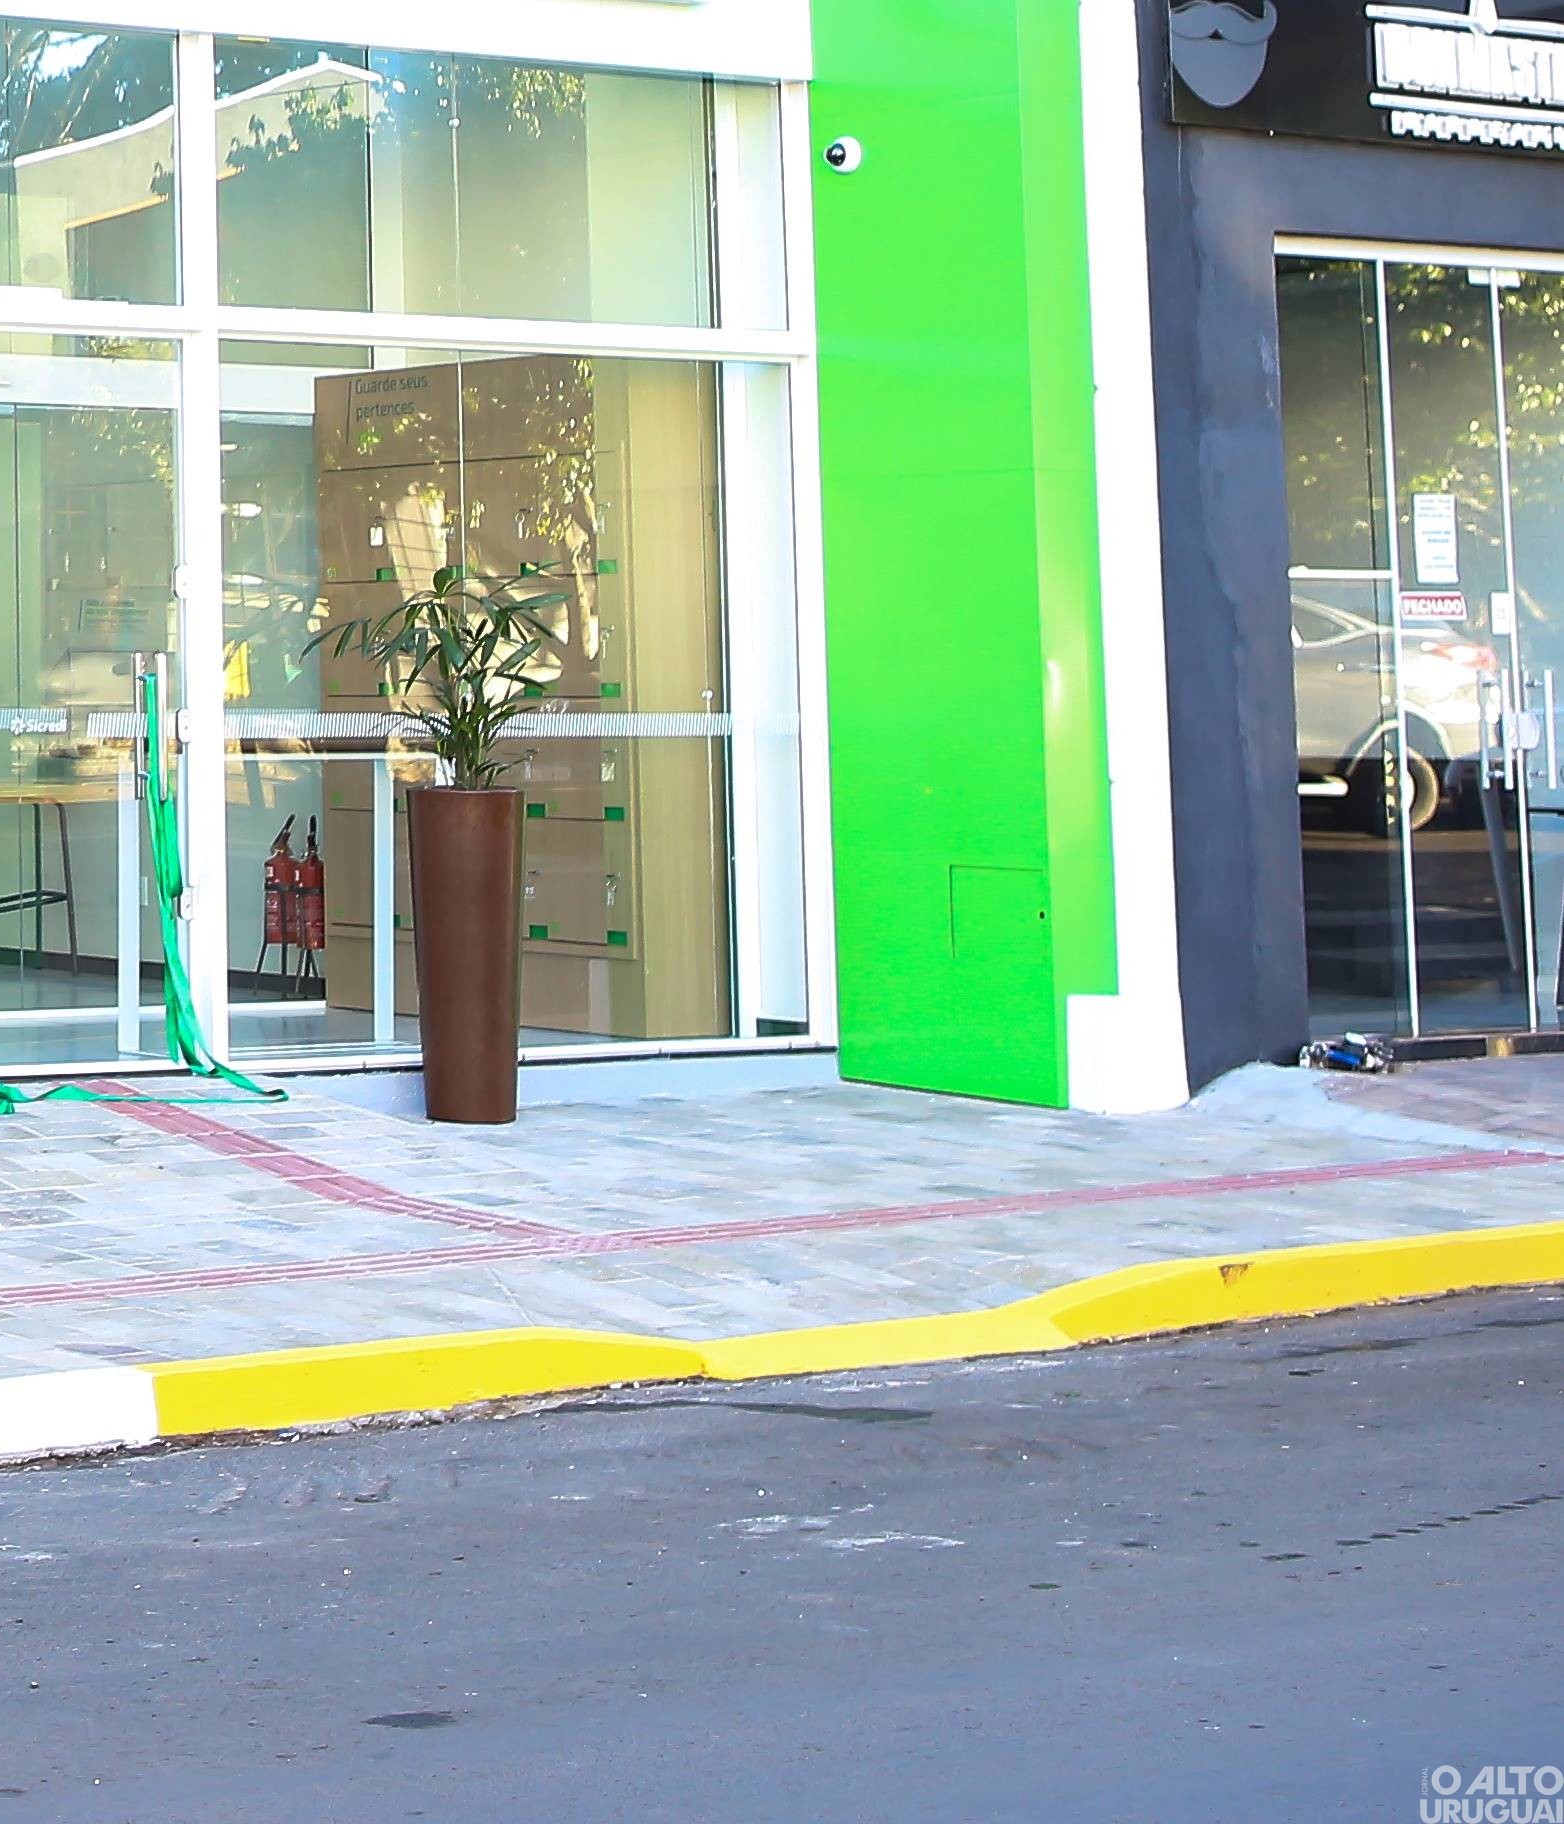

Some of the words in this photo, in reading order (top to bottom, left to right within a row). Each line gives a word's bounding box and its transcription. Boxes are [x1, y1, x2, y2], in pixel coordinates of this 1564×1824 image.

[355, 378, 397, 394] Guarde
[399, 375, 428, 389] seus
[356, 401, 415, 423] pertences
[26, 718, 68, 733] Sicredi
